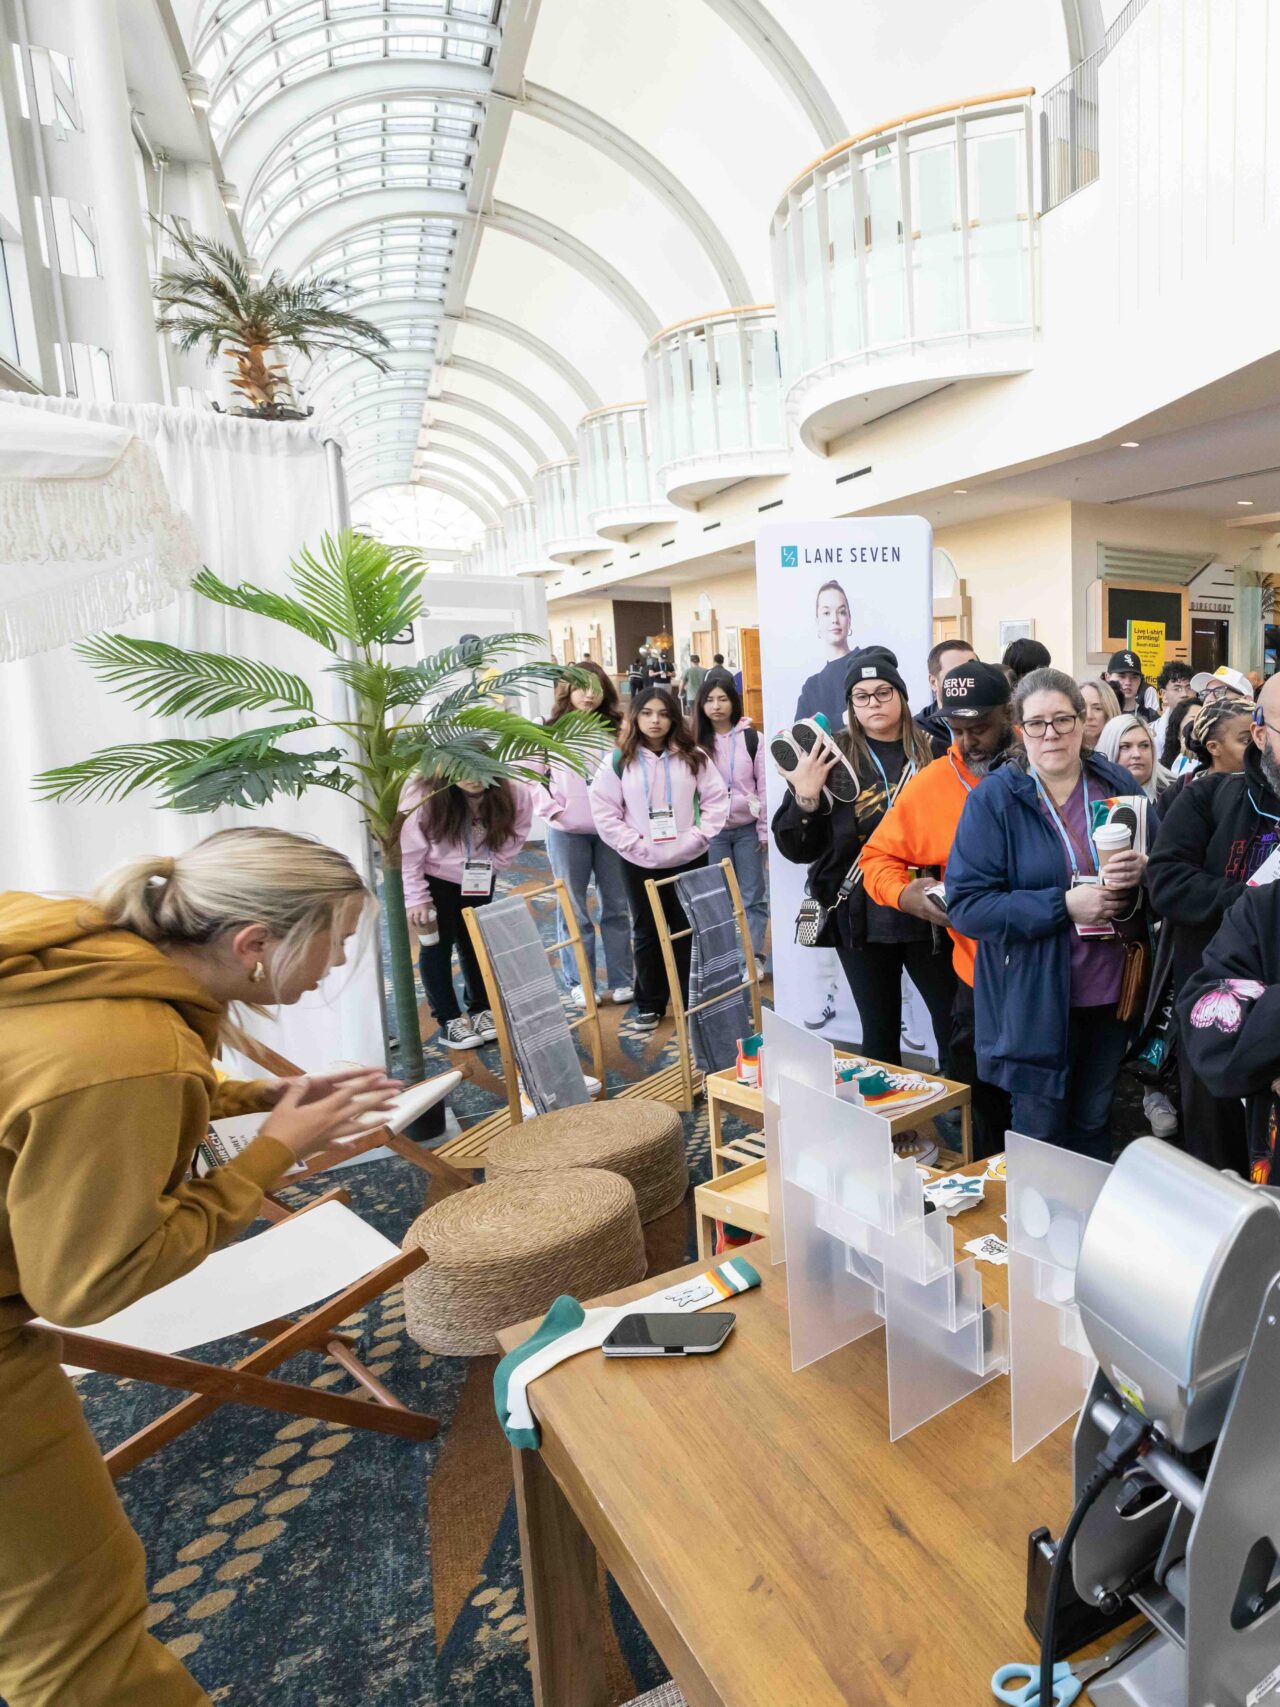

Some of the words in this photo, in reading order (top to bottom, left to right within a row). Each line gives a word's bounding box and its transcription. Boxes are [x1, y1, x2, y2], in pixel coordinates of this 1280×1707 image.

[804, 547, 843, 564] LANE
[850, 546, 901, 563] SEVEN
[1191, 601, 1232, 612] DIRECTORY
[943, 677, 975, 688] SERVE
[945, 687, 968, 697] GOD
